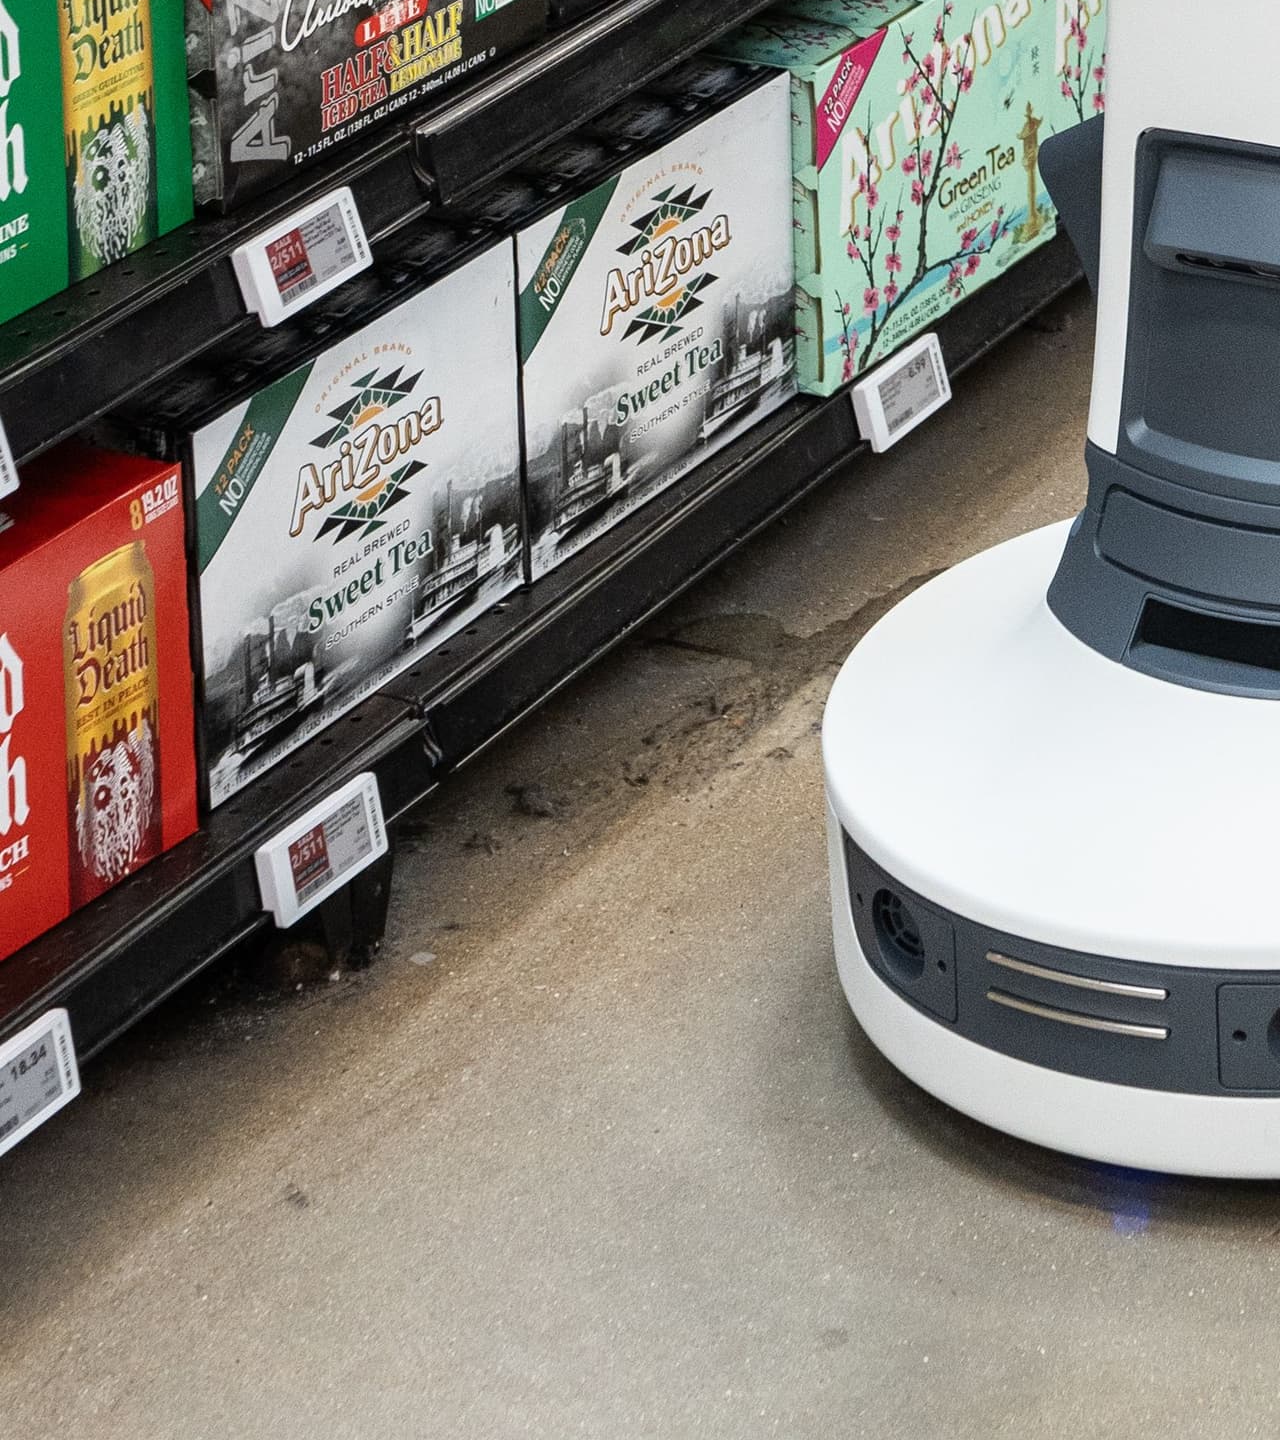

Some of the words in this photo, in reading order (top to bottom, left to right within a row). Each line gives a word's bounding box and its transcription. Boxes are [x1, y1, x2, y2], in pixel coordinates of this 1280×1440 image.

[72, 20, 145, 88] Death
[321, 40, 385, 109] HALF
[321, 94, 357, 132] ICED
[390, 36, 462, 95] LEMONADE
[938, 165, 986, 209] Green
[986, 144, 1015, 174] Tea
[599, 213, 732, 337] AriZona
[314, 352, 369, 414] ORIGINAL
[374, 342, 413, 357] BRAND
[616, 366, 682, 427] Sweet
[684, 337, 724, 380] Tea
[636, 348, 663, 377] REAL
[665, 326, 704, 363] BREWED
[226, 423, 255, 475] PACK
[631, 401, 679, 442] SOUTHERN
[218, 473, 245, 517] NO
[288, 395, 444, 537] AriZona
[308, 563, 385, 634] Sweet
[389, 528, 432, 575] Tea
[333, 548, 364, 579] REAL
[366, 519, 411, 561] BREWED
[68, 582, 148, 663] Liquid
[325, 602, 385, 650] SOUTHERN
[386, 579, 419, 611] STYLE
[75, 633, 150, 711] Death
[290, 835, 325, 868] 2/$11
